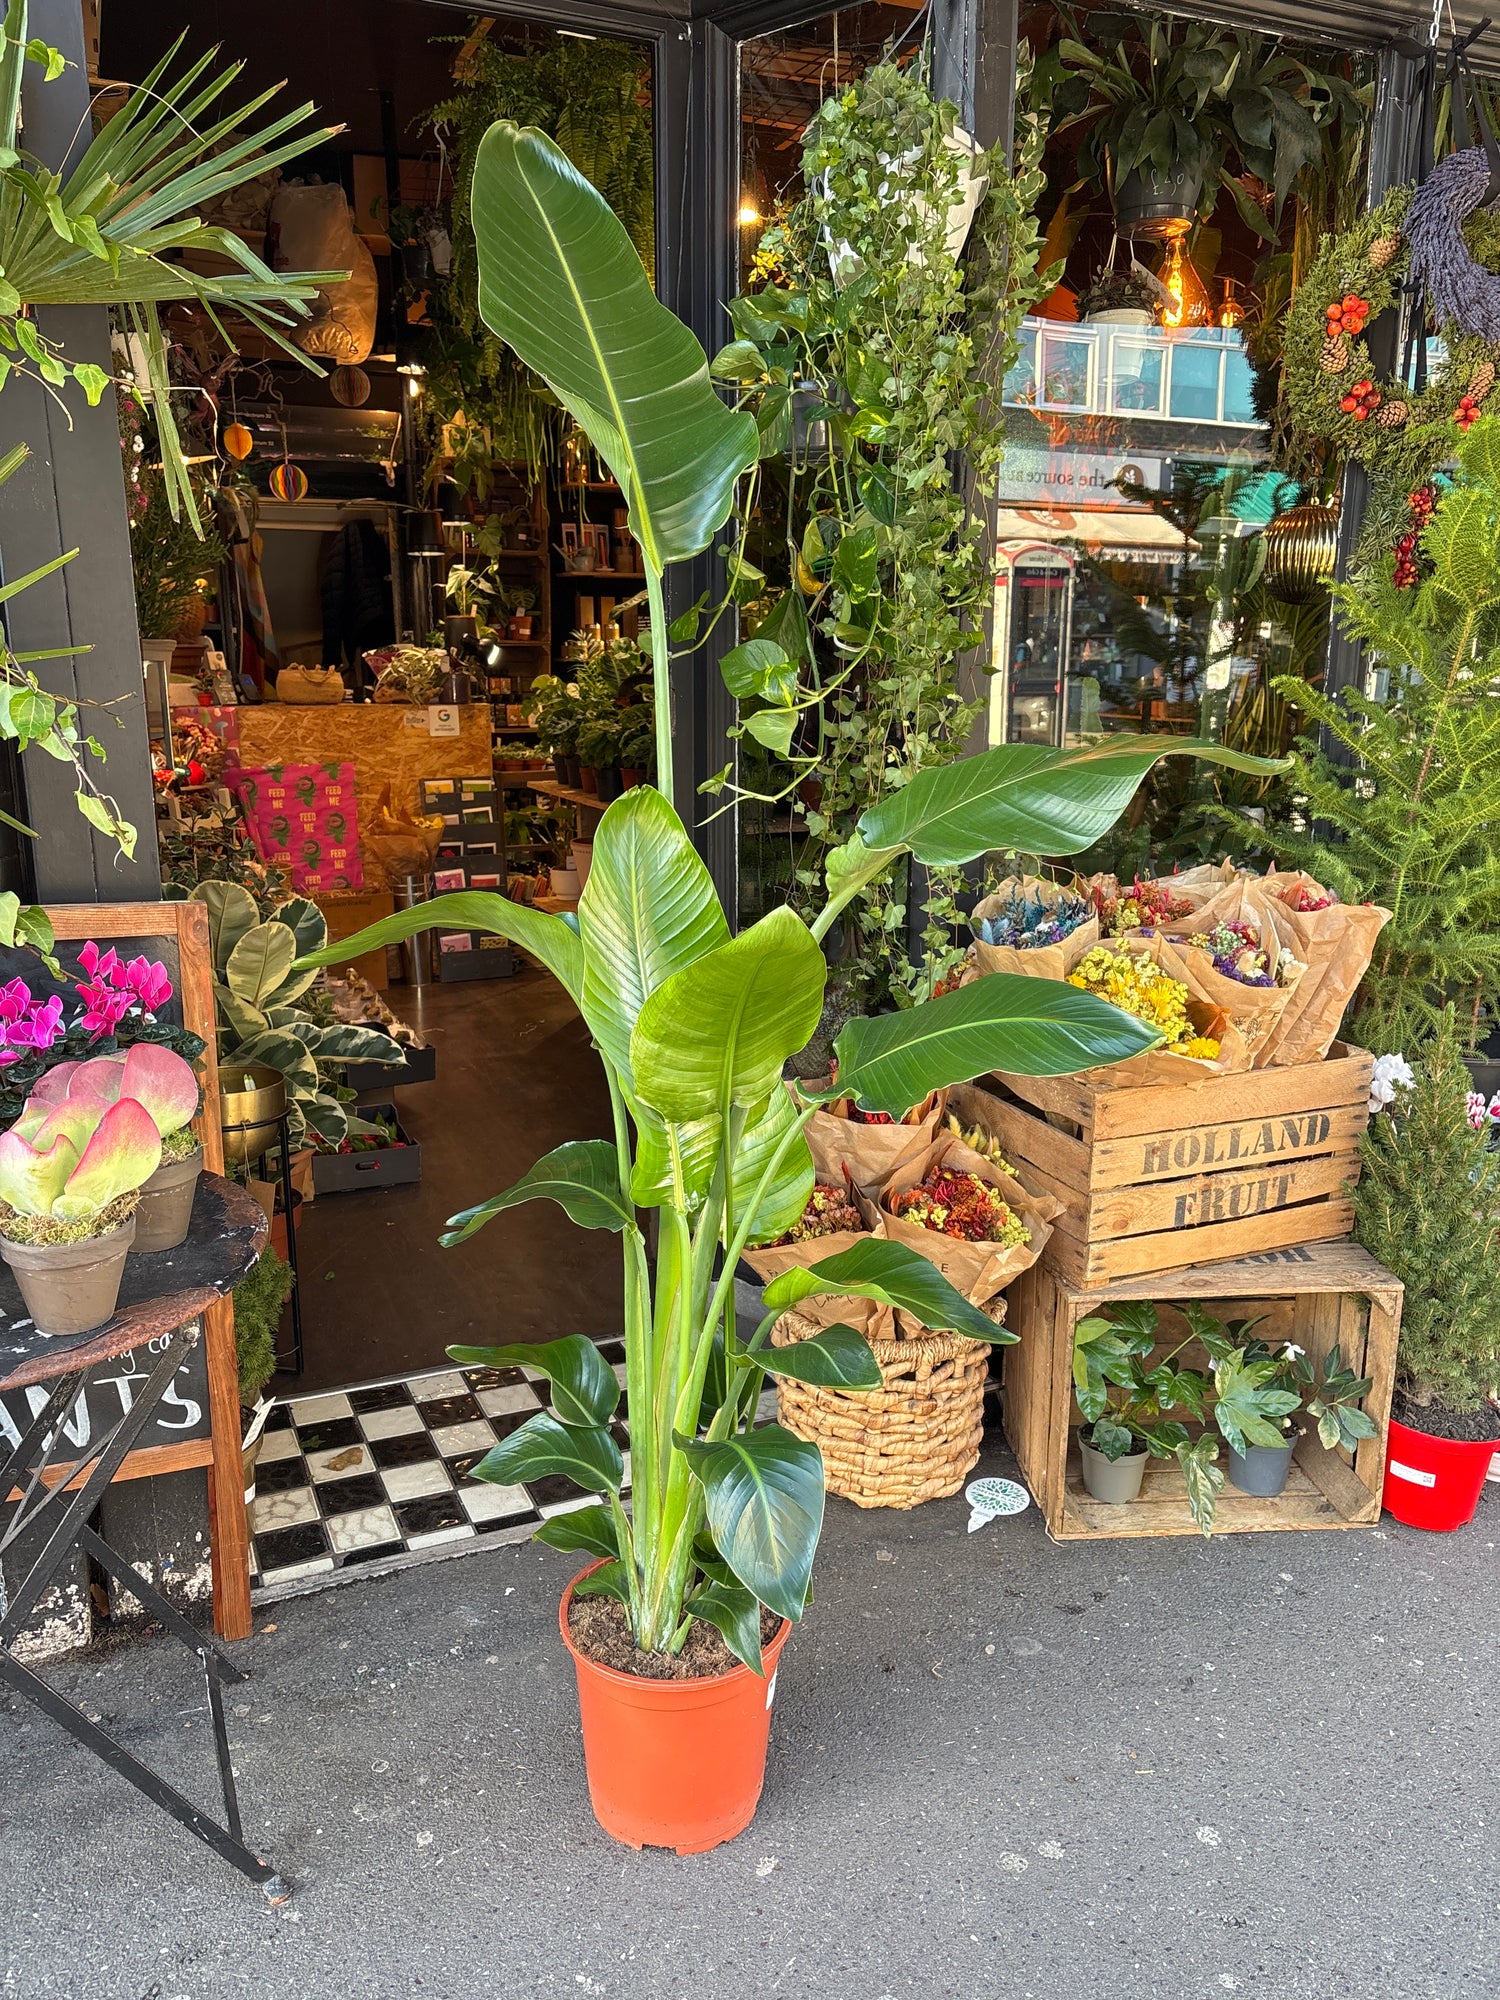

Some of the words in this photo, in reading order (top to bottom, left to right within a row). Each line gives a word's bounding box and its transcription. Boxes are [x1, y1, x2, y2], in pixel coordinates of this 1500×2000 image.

[268, 788, 286, 798] FEED
[325, 785, 342, 795] FEED
[272, 799, 284, 809] ME
[328, 796, 340, 806] ME
[299, 812, 317, 822] FEED
[303, 823, 314, 833] ME
[330, 848, 347, 858] FEED
[334, 859, 345, 869] ME
[304, 875, 322, 885] FEED
[1141, 1113, 1331, 1175] HOLLAND
[1174, 1173, 1296, 1229] FRUIT
